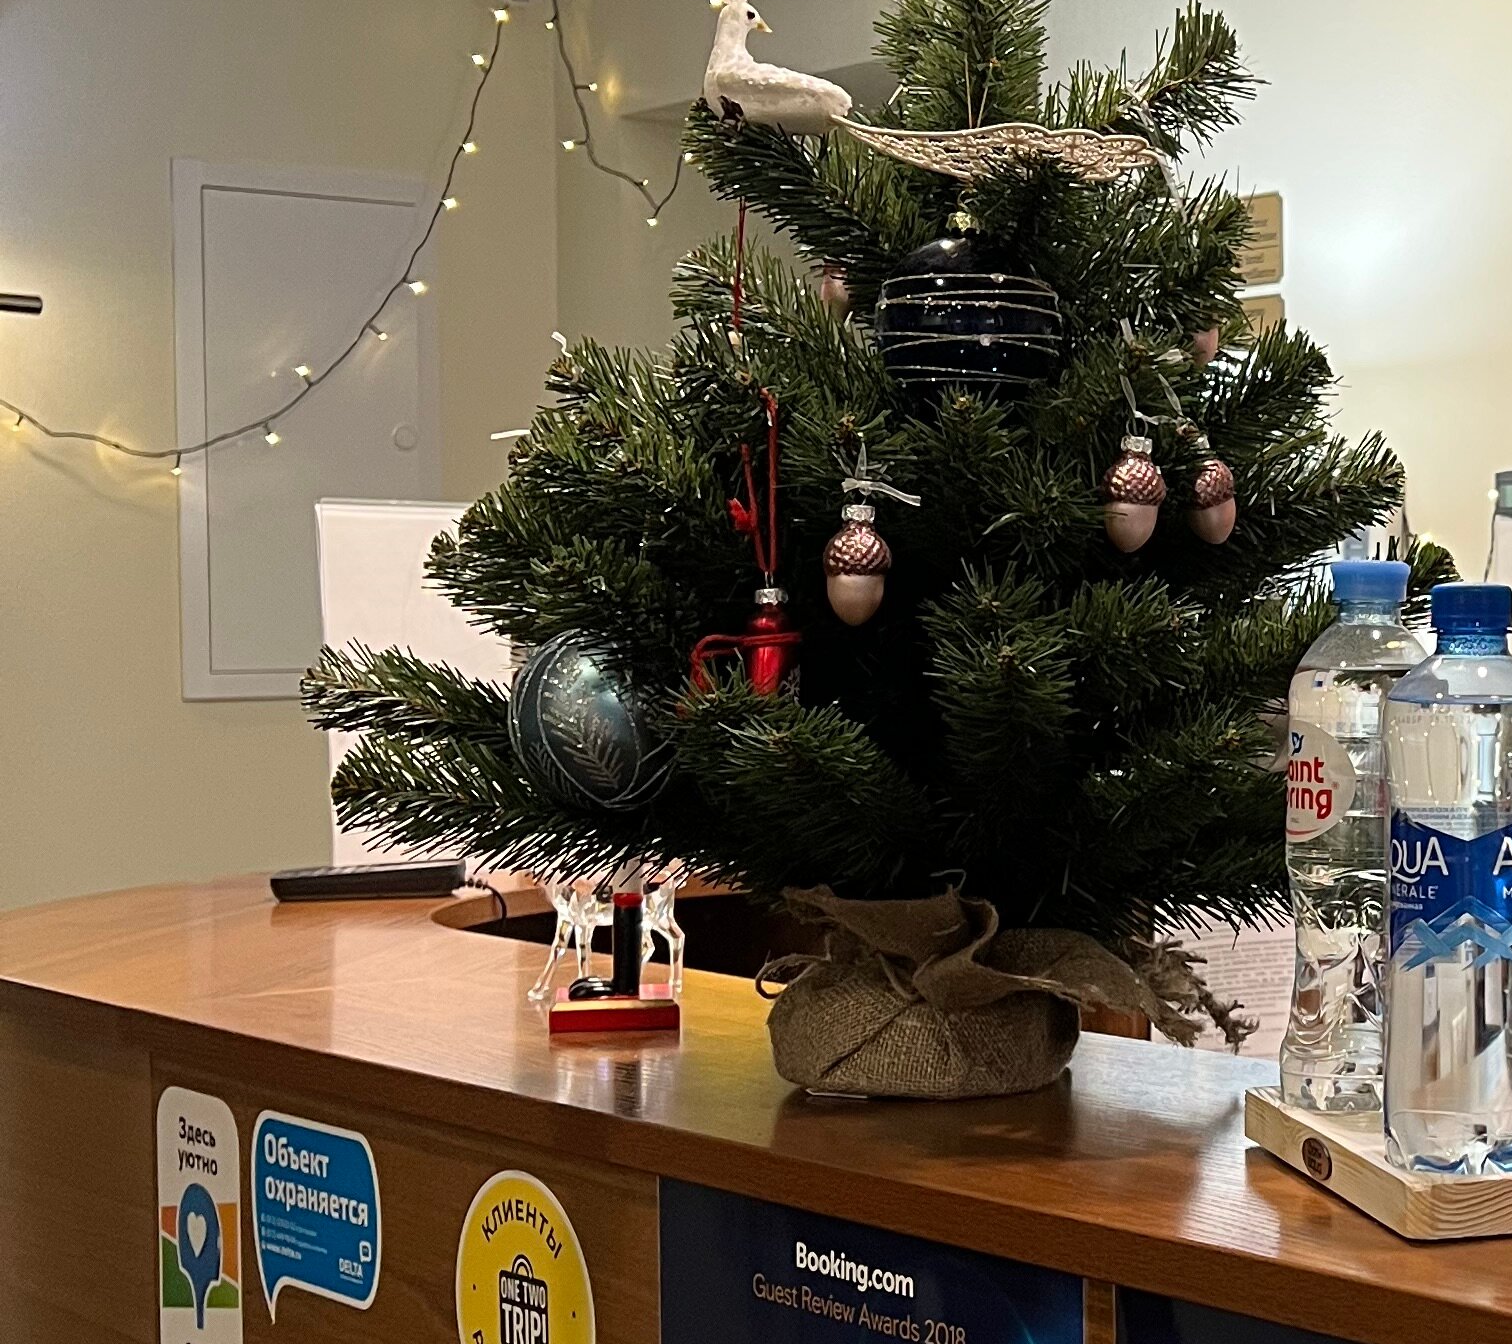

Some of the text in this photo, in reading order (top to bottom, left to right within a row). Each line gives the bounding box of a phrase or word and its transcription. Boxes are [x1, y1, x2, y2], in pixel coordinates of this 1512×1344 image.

[1286, 786, 1332, 819] ring
[178, 1116, 216, 1148] Здесь
[264, 1132, 329, 1178] Объект
[178, 1148, 218, 1176] уютно
[265, 1176, 369, 1227] охраняется
[481, 1199, 563, 1259] КЛИЕНТЫ
[500, 1276, 546, 1309] ONE TWO
[795, 1240, 914, 1300] Booking.com
[752, 1272, 798, 1311] Guest
[801, 1290, 854, 1326] Review
[858, 1301, 920, 1344] Awards
